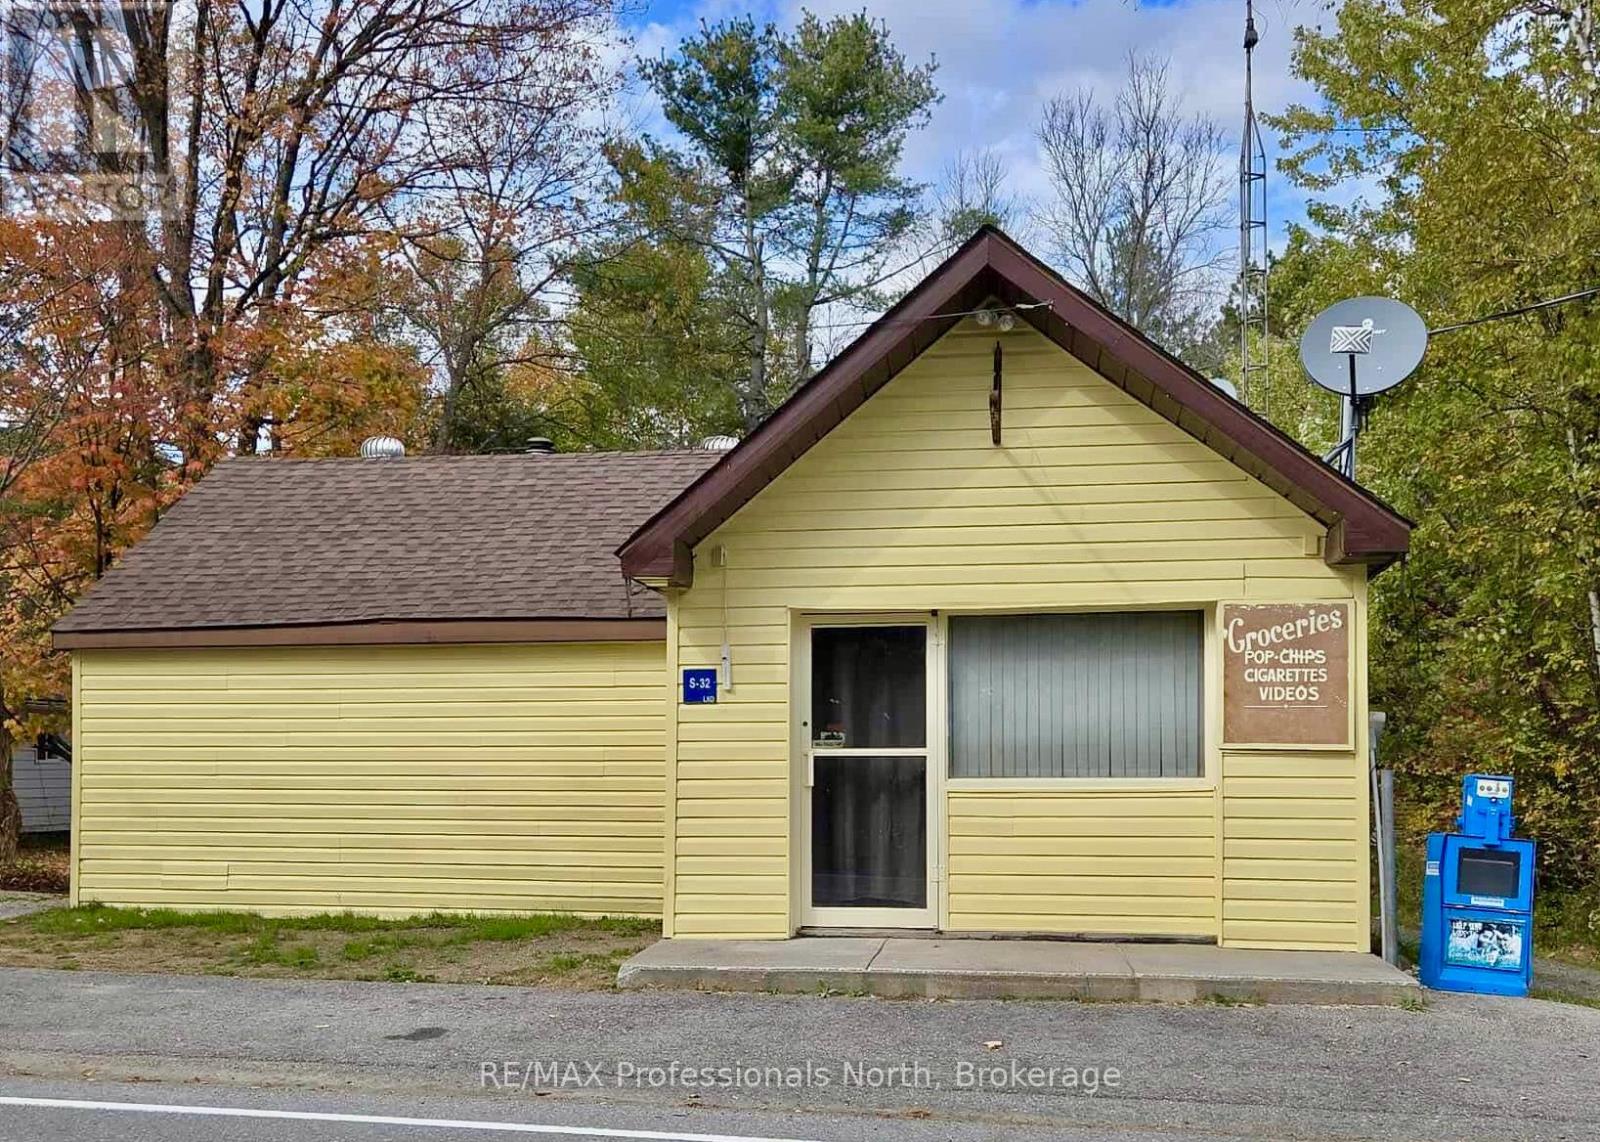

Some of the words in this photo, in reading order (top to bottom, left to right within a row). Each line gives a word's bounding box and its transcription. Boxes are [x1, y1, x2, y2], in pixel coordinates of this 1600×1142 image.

[1228, 609, 1343, 653] Groceries
[1244, 668, 1328, 682] CIGARETTES
[689, 677, 711, 689] S-32
[1259, 686, 1320, 701] VIDEOS
